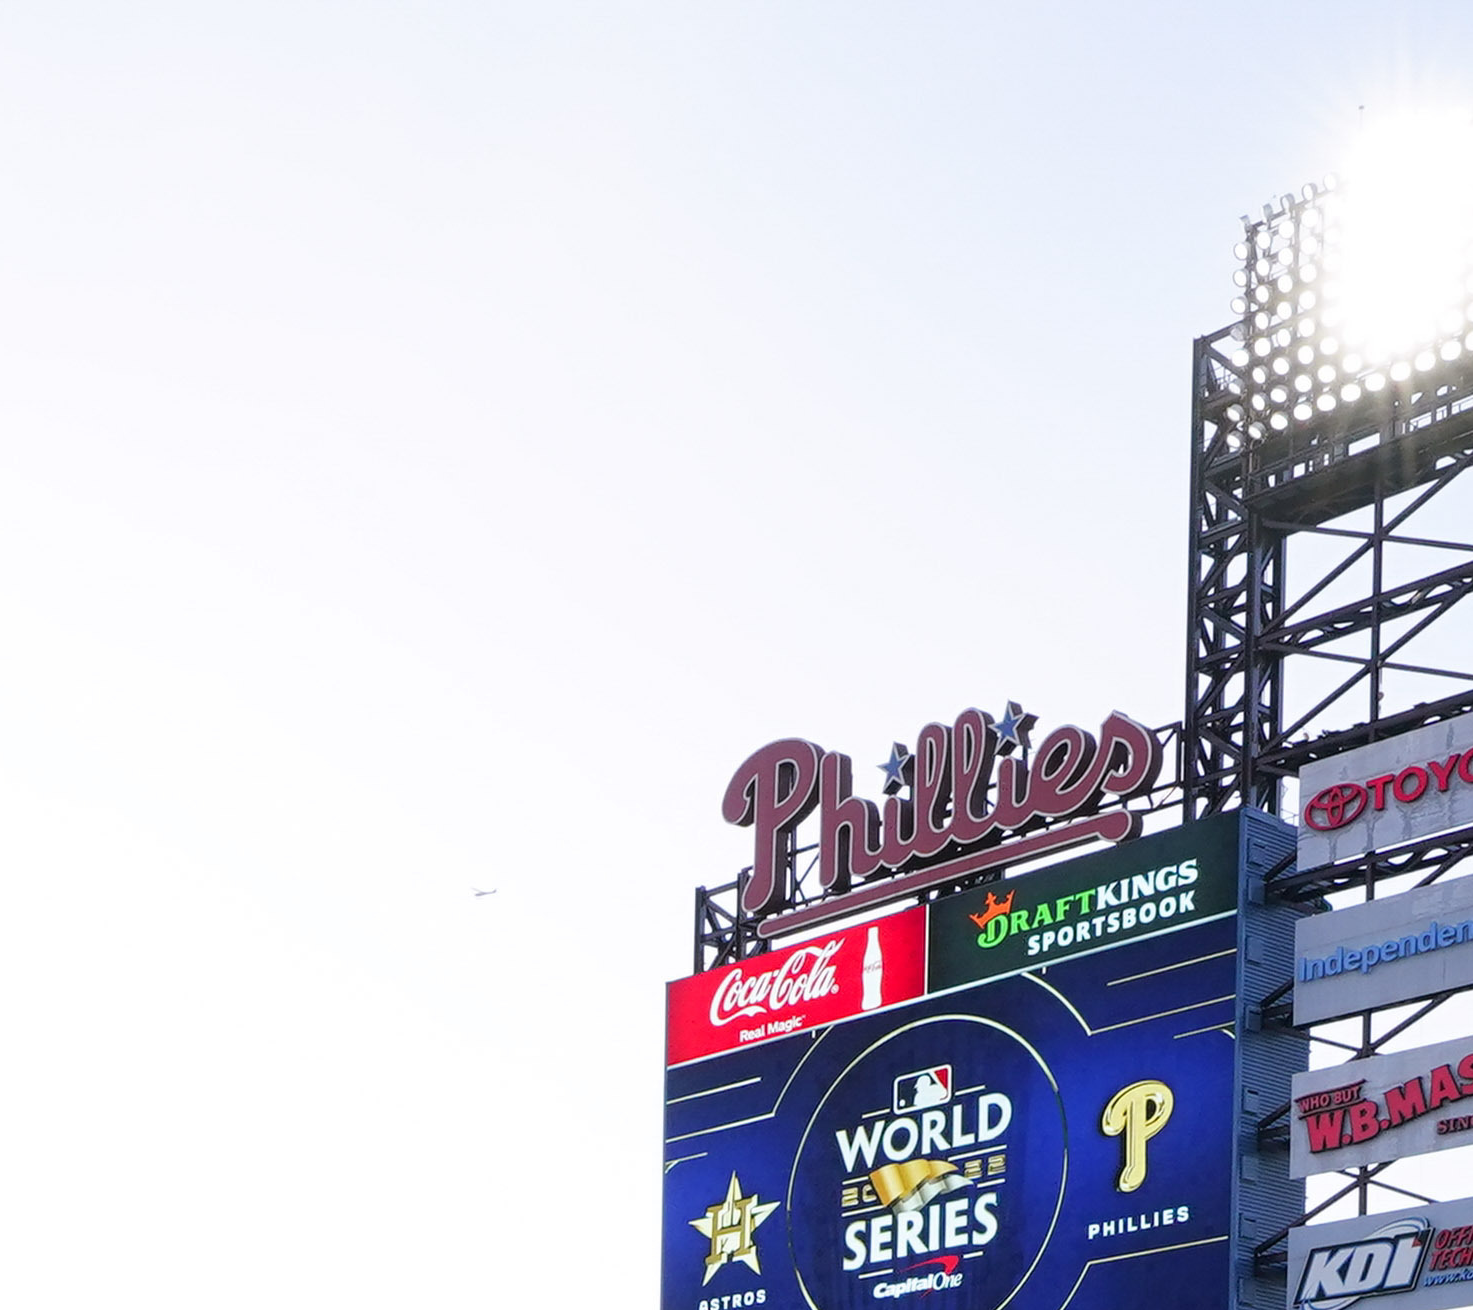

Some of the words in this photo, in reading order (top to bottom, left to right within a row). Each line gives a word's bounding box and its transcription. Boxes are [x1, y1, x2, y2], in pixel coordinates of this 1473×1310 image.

[723, 708, 1162, 913] Phillies
[977, 859, 1199, 948] DRAFTKINGS
[1027, 890, 1195, 956] SPORTSBOOK
[710, 938, 846, 1027] Coca-Cola
[740, 1022, 766, 1043] Real
[767, 1016, 805, 1035] Magic
[836, 1092, 1012, 1173] WORLD
[1298, 1093, 1330, 1114] WHO
[1332, 1084, 1361, 1106] BUT
[843, 1192, 999, 1271] SERIES
[1088, 1206, 1190, 1240] PHILLIES
[1300, 1231, 1423, 1300] KDI
